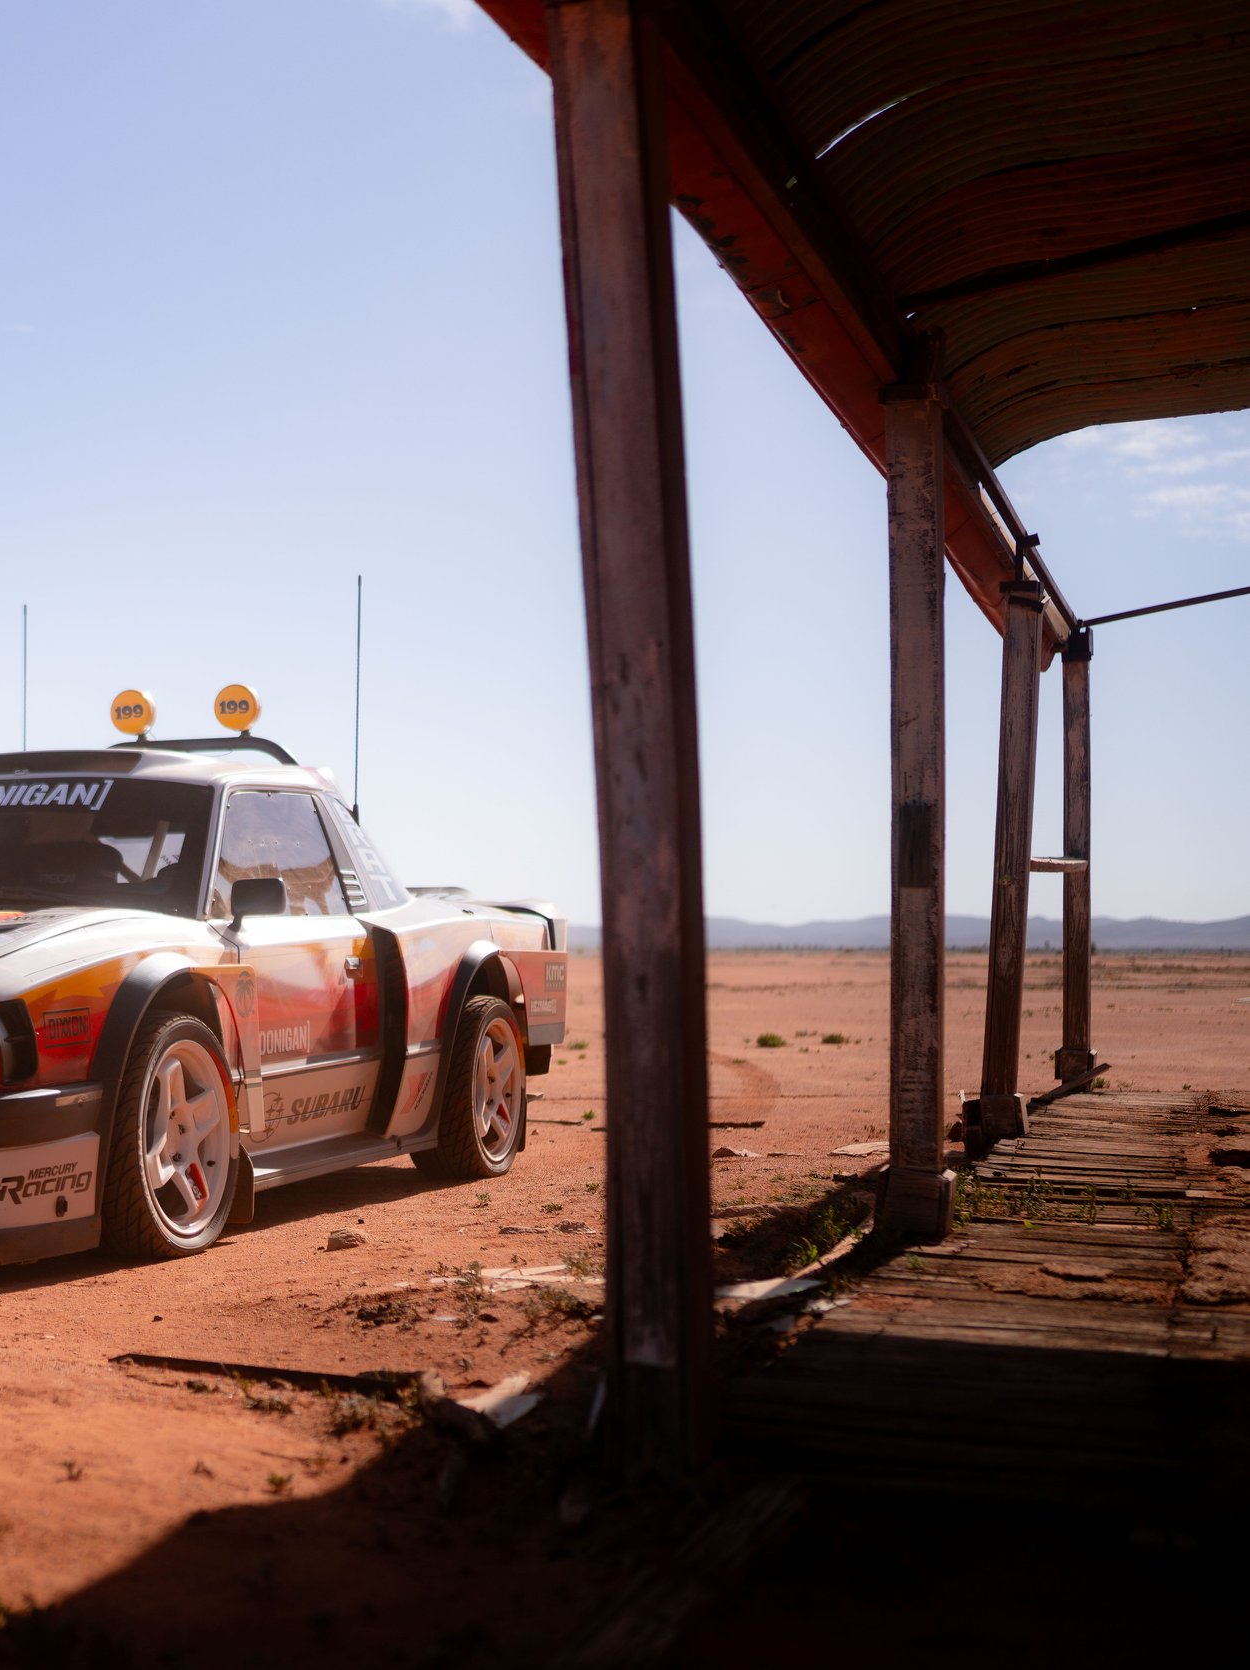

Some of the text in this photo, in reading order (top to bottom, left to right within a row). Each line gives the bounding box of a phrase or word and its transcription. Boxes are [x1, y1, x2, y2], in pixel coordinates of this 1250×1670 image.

[114, 704, 144, 720] 199
[219, 699, 250, 715] 199
[260, 1020, 310, 1056] OONIGAN]
[287, 1085, 366, 1126] SUBARU
[27, 1162, 79, 1180] MERCURY
